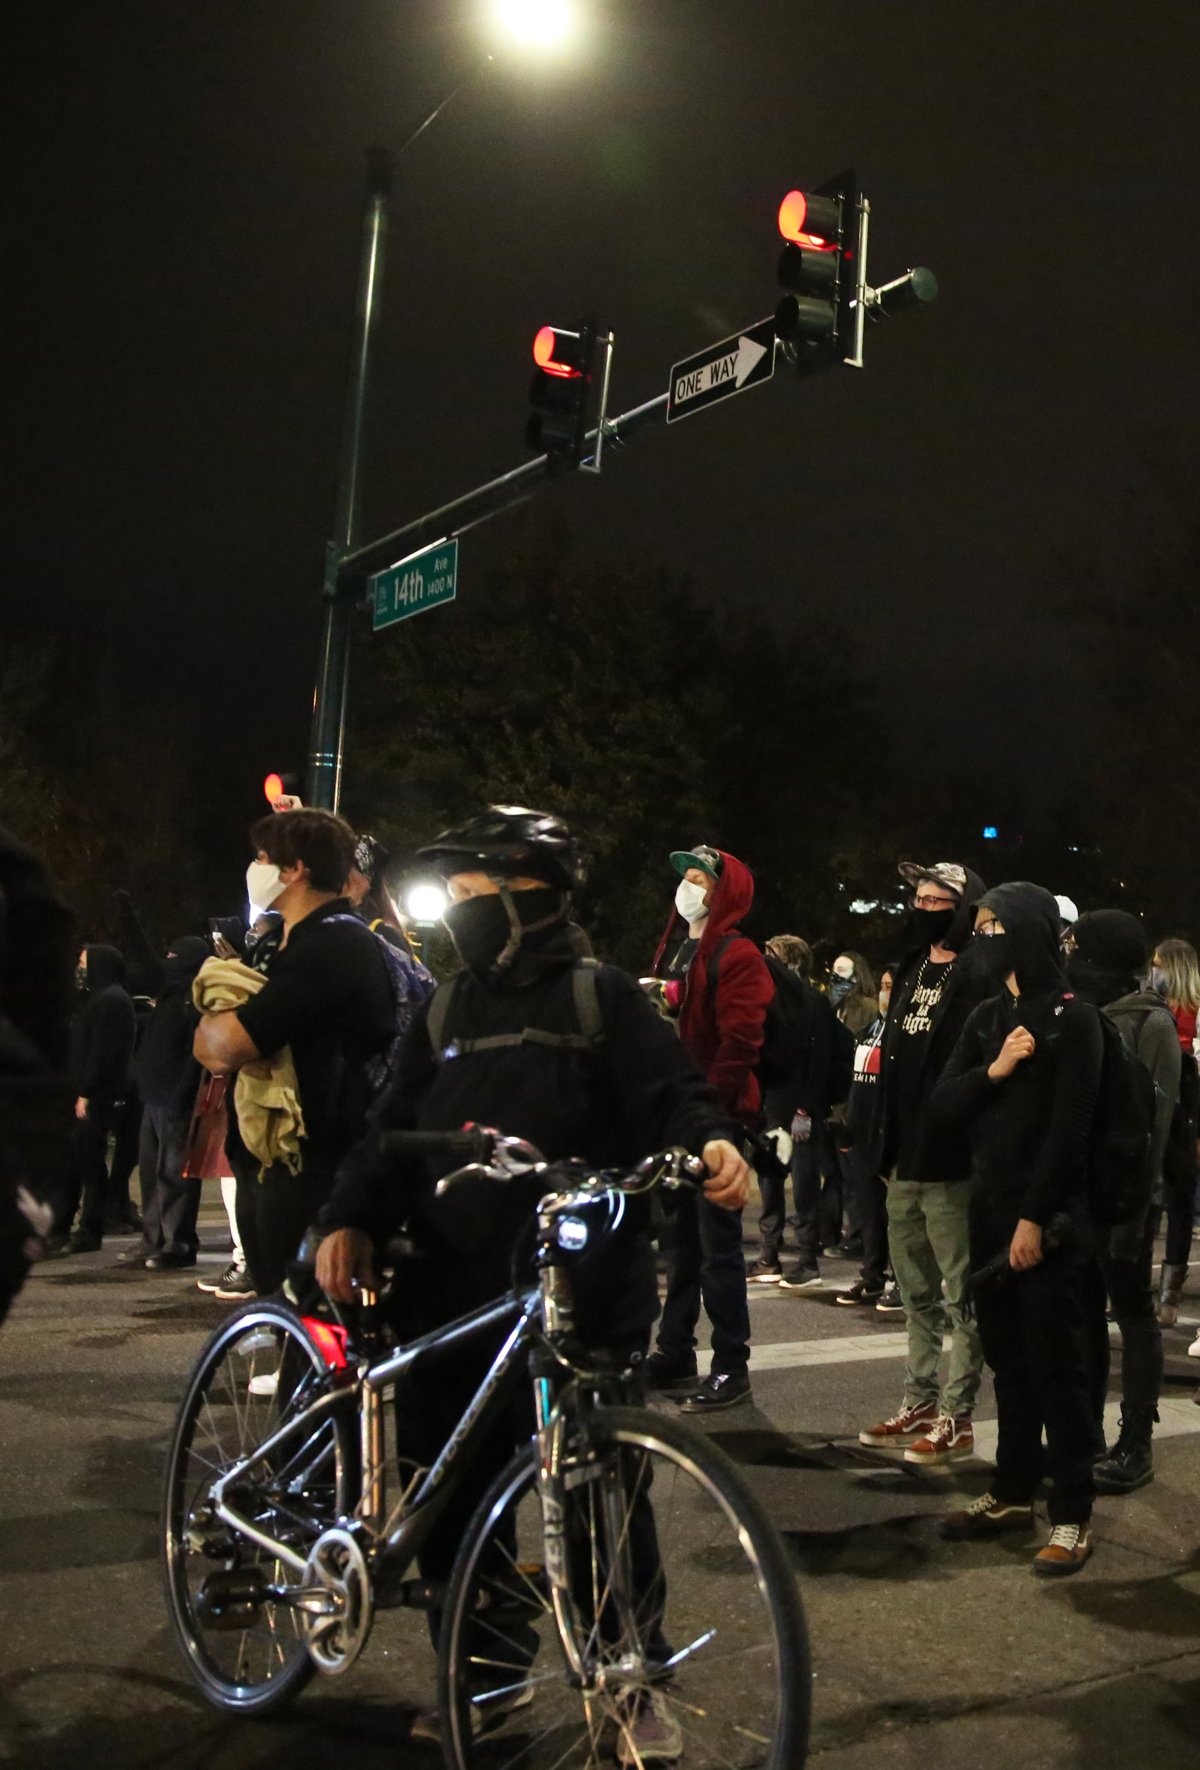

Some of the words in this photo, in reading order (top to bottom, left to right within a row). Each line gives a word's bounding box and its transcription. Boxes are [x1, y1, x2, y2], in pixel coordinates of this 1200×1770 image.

[677, 370, 704, 400] ONE
[710, 352, 739, 385] WAY
[434, 557, 448, 573] Ave
[394, 569, 424, 610] 14th
